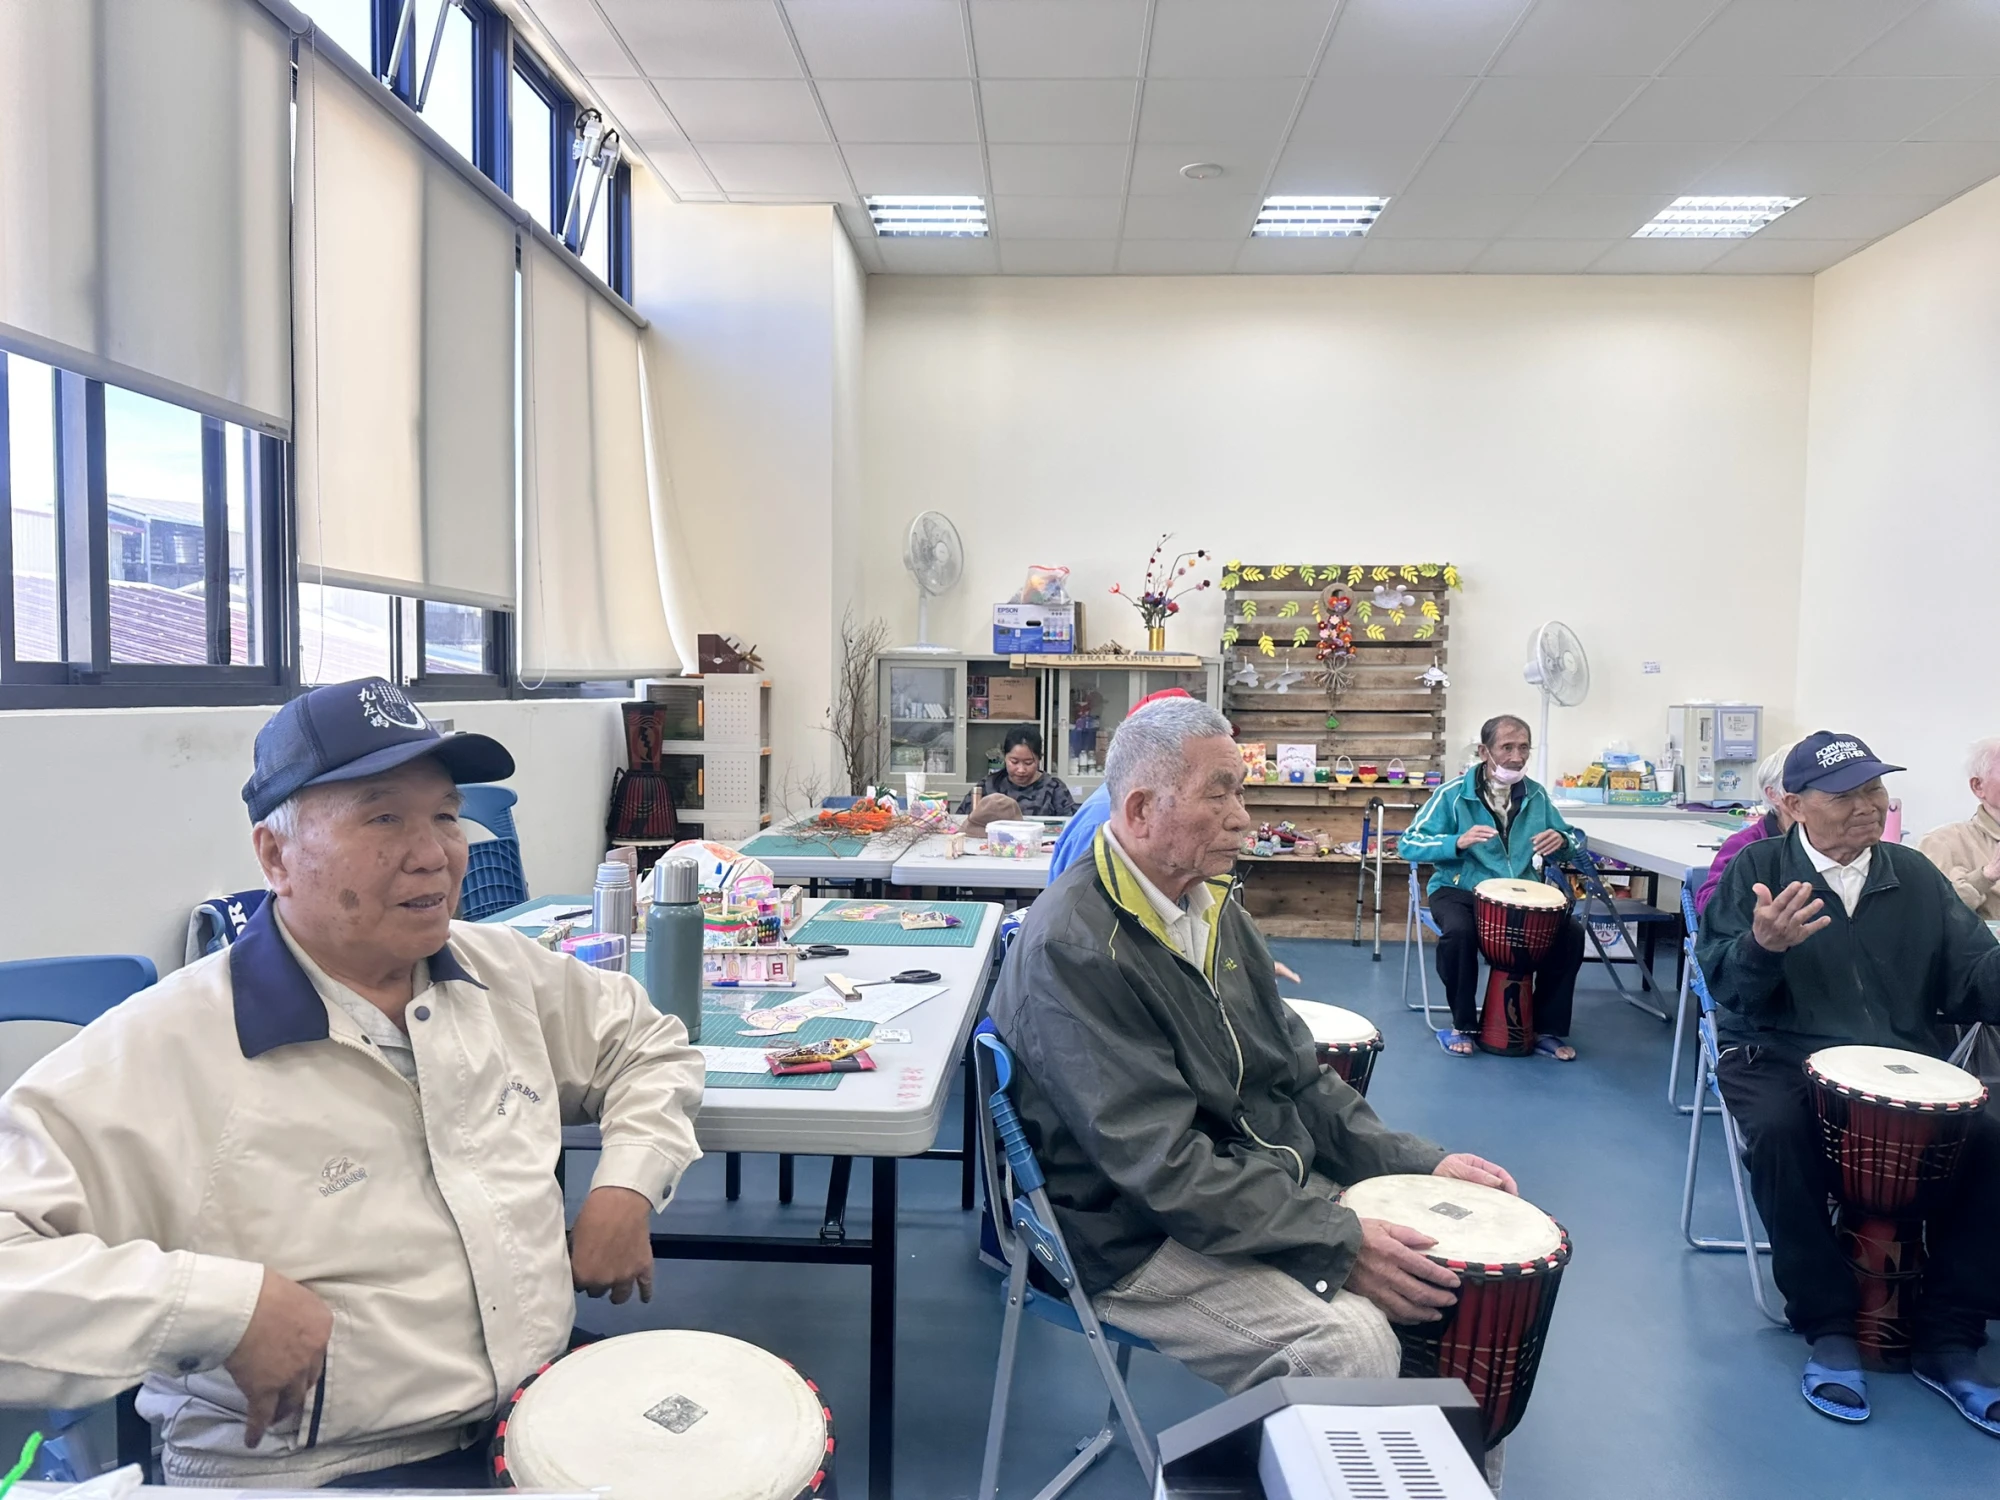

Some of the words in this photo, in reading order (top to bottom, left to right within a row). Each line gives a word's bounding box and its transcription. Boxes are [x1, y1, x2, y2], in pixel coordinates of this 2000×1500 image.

[1058, 654, 1106, 662] LATERAL
[1115, 655, 1165, 663] CABINET
[1815, 741, 1858, 759] FORWARD
[1818, 749, 1867, 768] TOGETHER
[772, 962, 784, 975] 日
